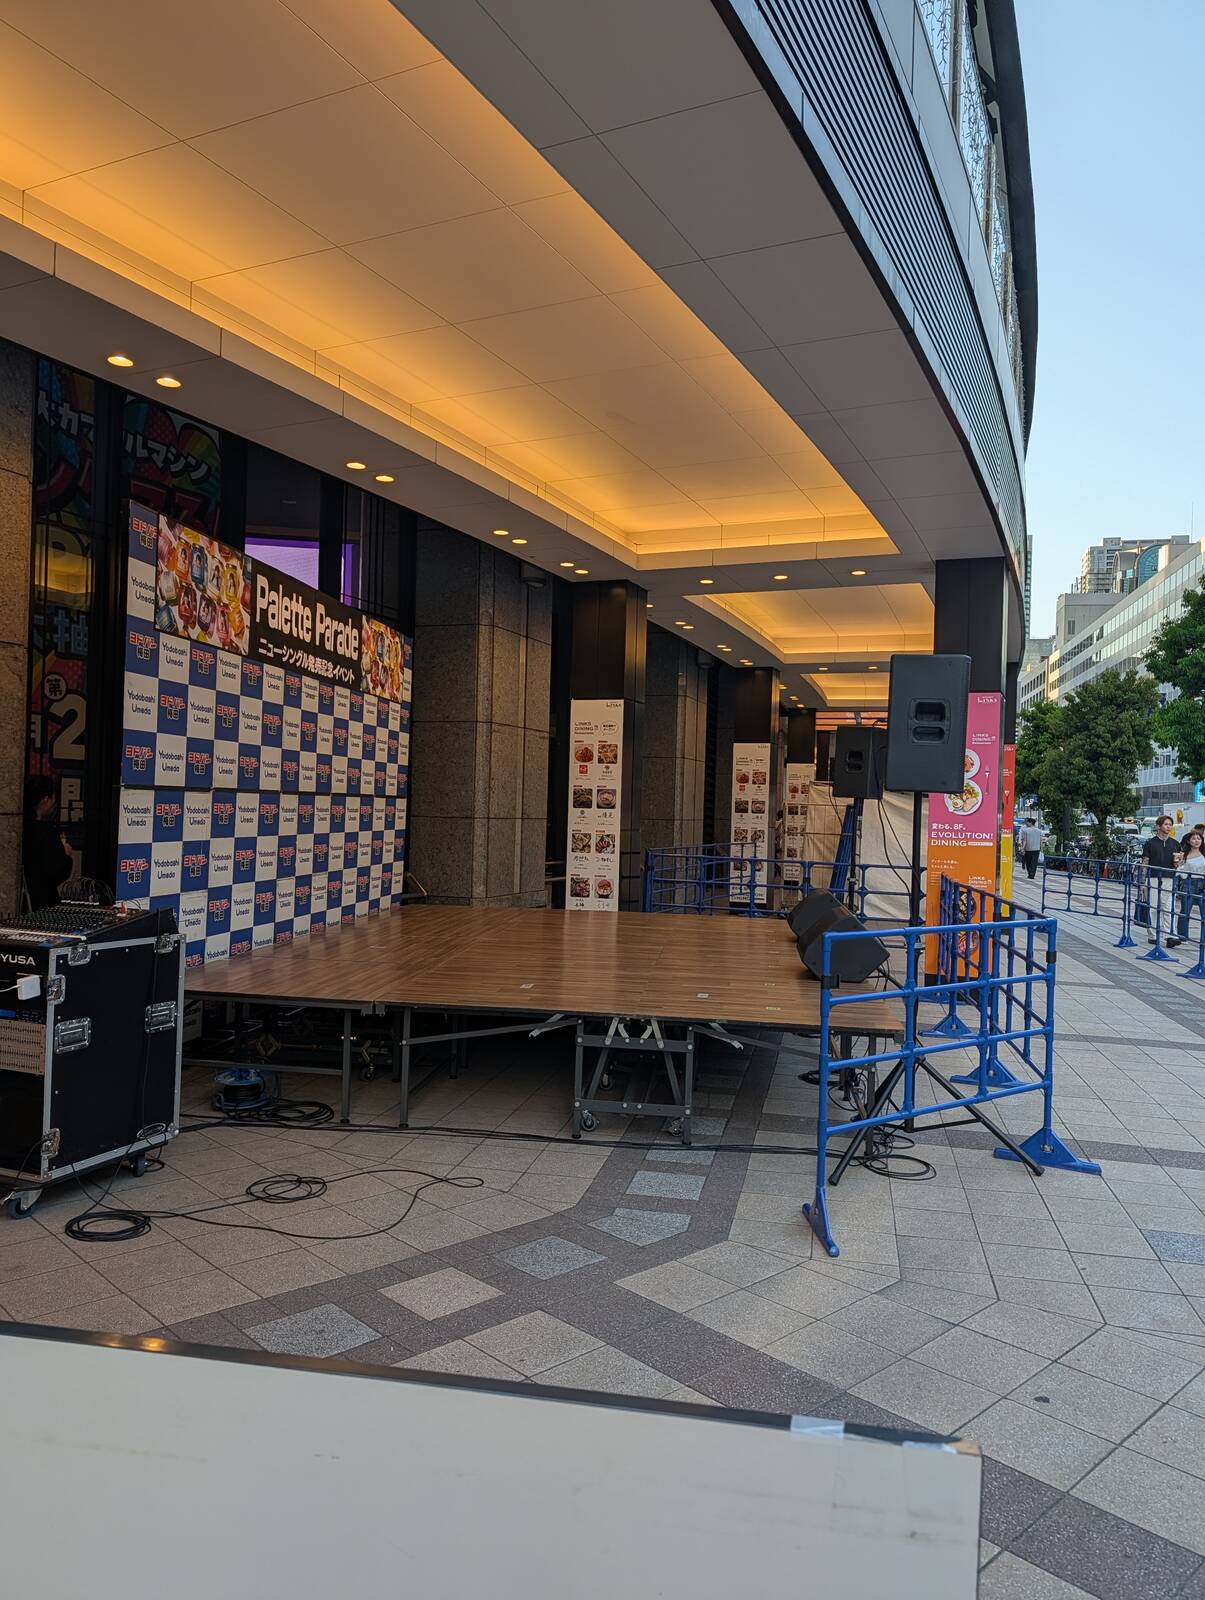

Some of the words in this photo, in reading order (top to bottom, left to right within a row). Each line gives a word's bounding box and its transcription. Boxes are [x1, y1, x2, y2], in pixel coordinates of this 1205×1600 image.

[139, 531, 153, 550] 梅田
[256, 574, 312, 643] Palette
[315, 603, 359, 660] Parade
[129, 631, 156, 650] ヨドバシ
[136, 644, 150, 661] 梅田
[162, 642, 187, 658] Yodobashi
[166, 655, 184, 668] Umeda
[218, 658, 239, 672] Yodobashi
[258, 638, 356, 684] ニューシングル発売記念イベント
[222, 670, 236, 681] Umeda
[127, 689, 156, 704] Yodobashi
[160, 694, 185, 710] ヨドバシ
[132, 703, 151, 715] Umeda
[167, 706, 179, 721] 梅田
[190, 701, 213, 714] Yodobashi
[194, 714, 210, 724] Umeda
[126, 745, 153, 759] ヨドバシ
[159, 749, 184, 761] Yodobashi
[133, 756, 147, 771] 梅田
[215, 755, 236, 765] Yodobashi
[163, 762, 180, 772] Umeda
[219, 767, 233, 775] Umeda
[123, 804, 152, 814] Yodobashi
[156, 803, 181, 815] ヨドバシ
[186, 805, 210, 814] Yodobashi
[128, 817, 147, 826] Umeda
[163, 814, 176, 827] 梅田
[190, 817, 206, 825] Umeda
[931, 831, 994, 840] EVOLUTION!
[931, 839, 967, 847] DINING
[154, 857, 180, 869] Yodobashi
[211, 853, 232, 863] Yodobashi
[121, 859, 149, 873] ヨドバシ
[214, 864, 229, 874] Umeda
[128, 870, 142, 885] 梅田
[158, 870, 176, 880] Umeda
[182, 905, 205, 918] Yodobashi
[185, 917, 202, 928] Umeda
